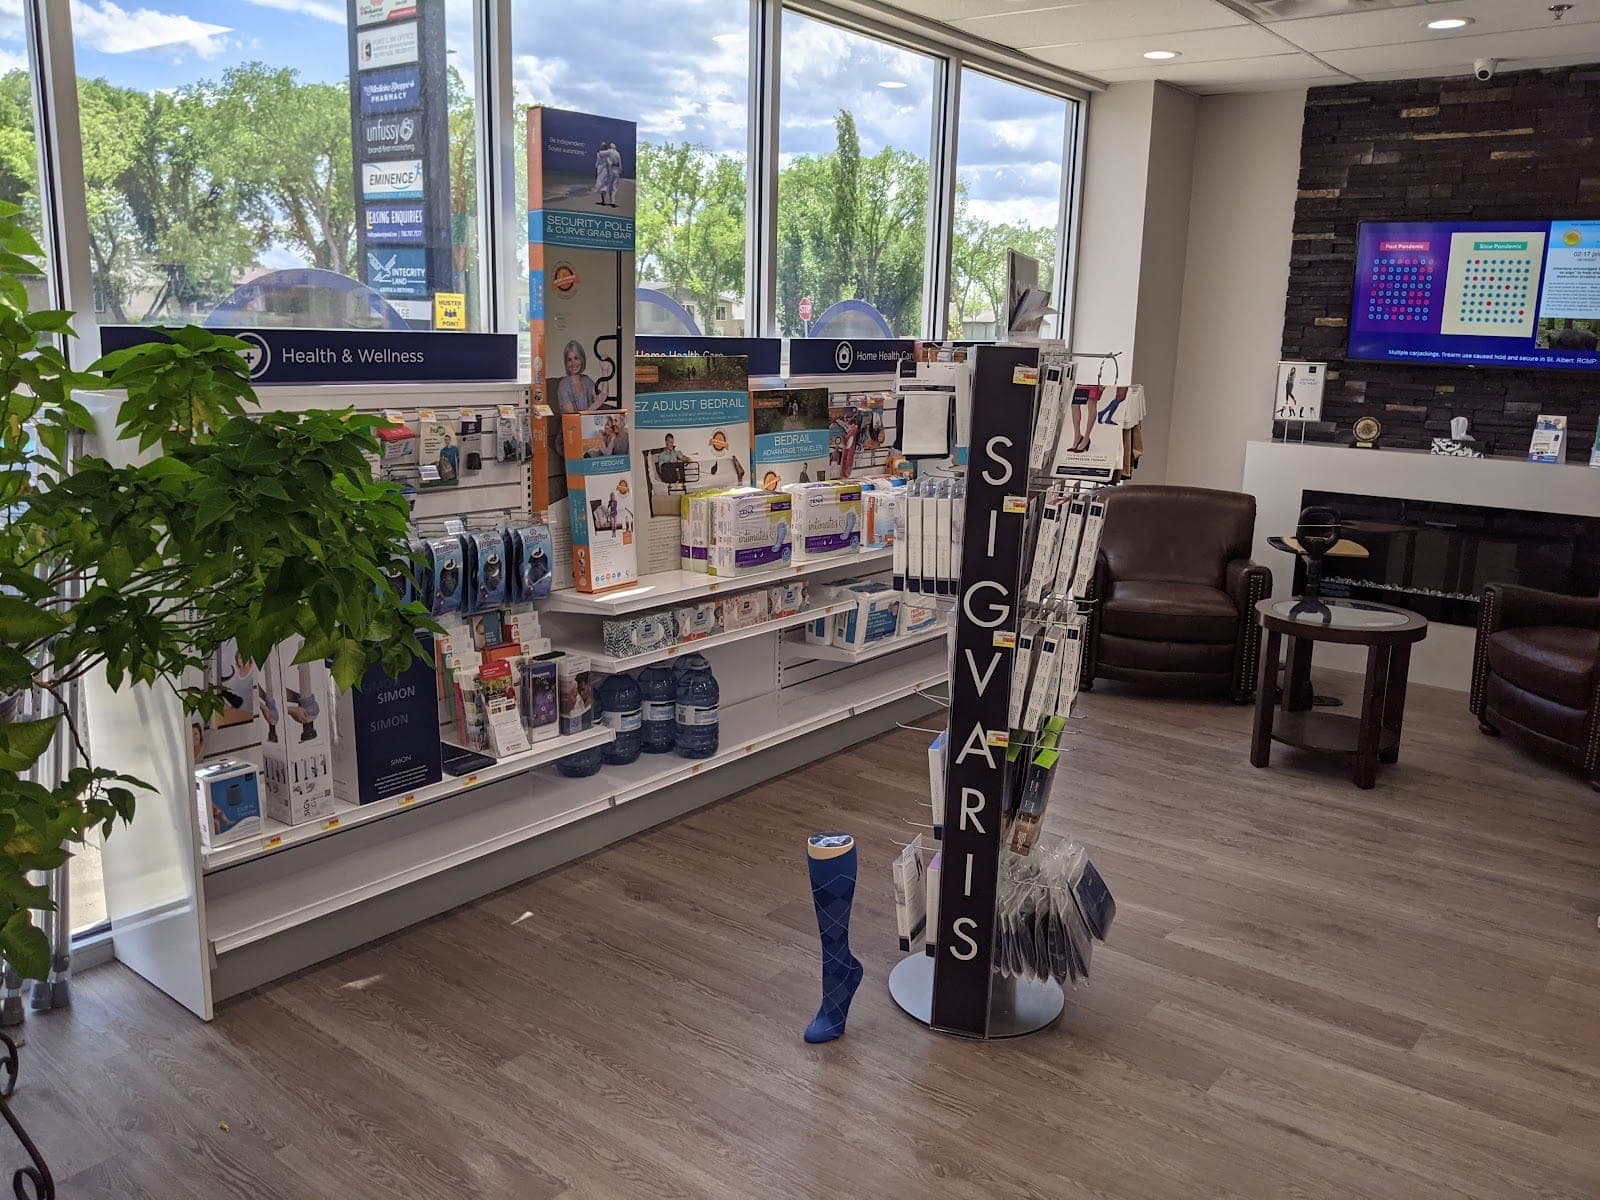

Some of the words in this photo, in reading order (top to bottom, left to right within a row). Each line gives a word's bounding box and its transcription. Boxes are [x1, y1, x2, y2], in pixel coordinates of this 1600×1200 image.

[367, 119, 400, 144] unfussy
[369, 171, 414, 186] EMINENCE
[547, 215, 602, 230] SECURITY
[604, 221, 633, 233] POLE
[547, 225, 554, 233] &
[555, 226, 586, 237] CURVE
[587, 229, 612, 239] GRAB
[613, 231, 632, 240] BAR
[391, 267, 426, 277] INTEGRITY
[282, 348, 338, 364] Health
[342, 348, 353, 364] &
[357, 348, 425, 364] Wellness
[856, 350, 878, 361] Home
[878, 350, 901, 361] Health
[635, 401, 649, 412] EZ
[652, 399, 697, 411] ADJUST
[700, 398, 745, 410] BEDRAIL
[774, 434, 813, 446] BEDRAIL
[763, 447, 796, 457] ADVANTAGE
[377, 685, 416, 705] SIMON
[950, 435, 1014, 961] SIGVARIS
[370, 713, 409, 733] SIMON
[390, 754, 412, 766] SIMON
